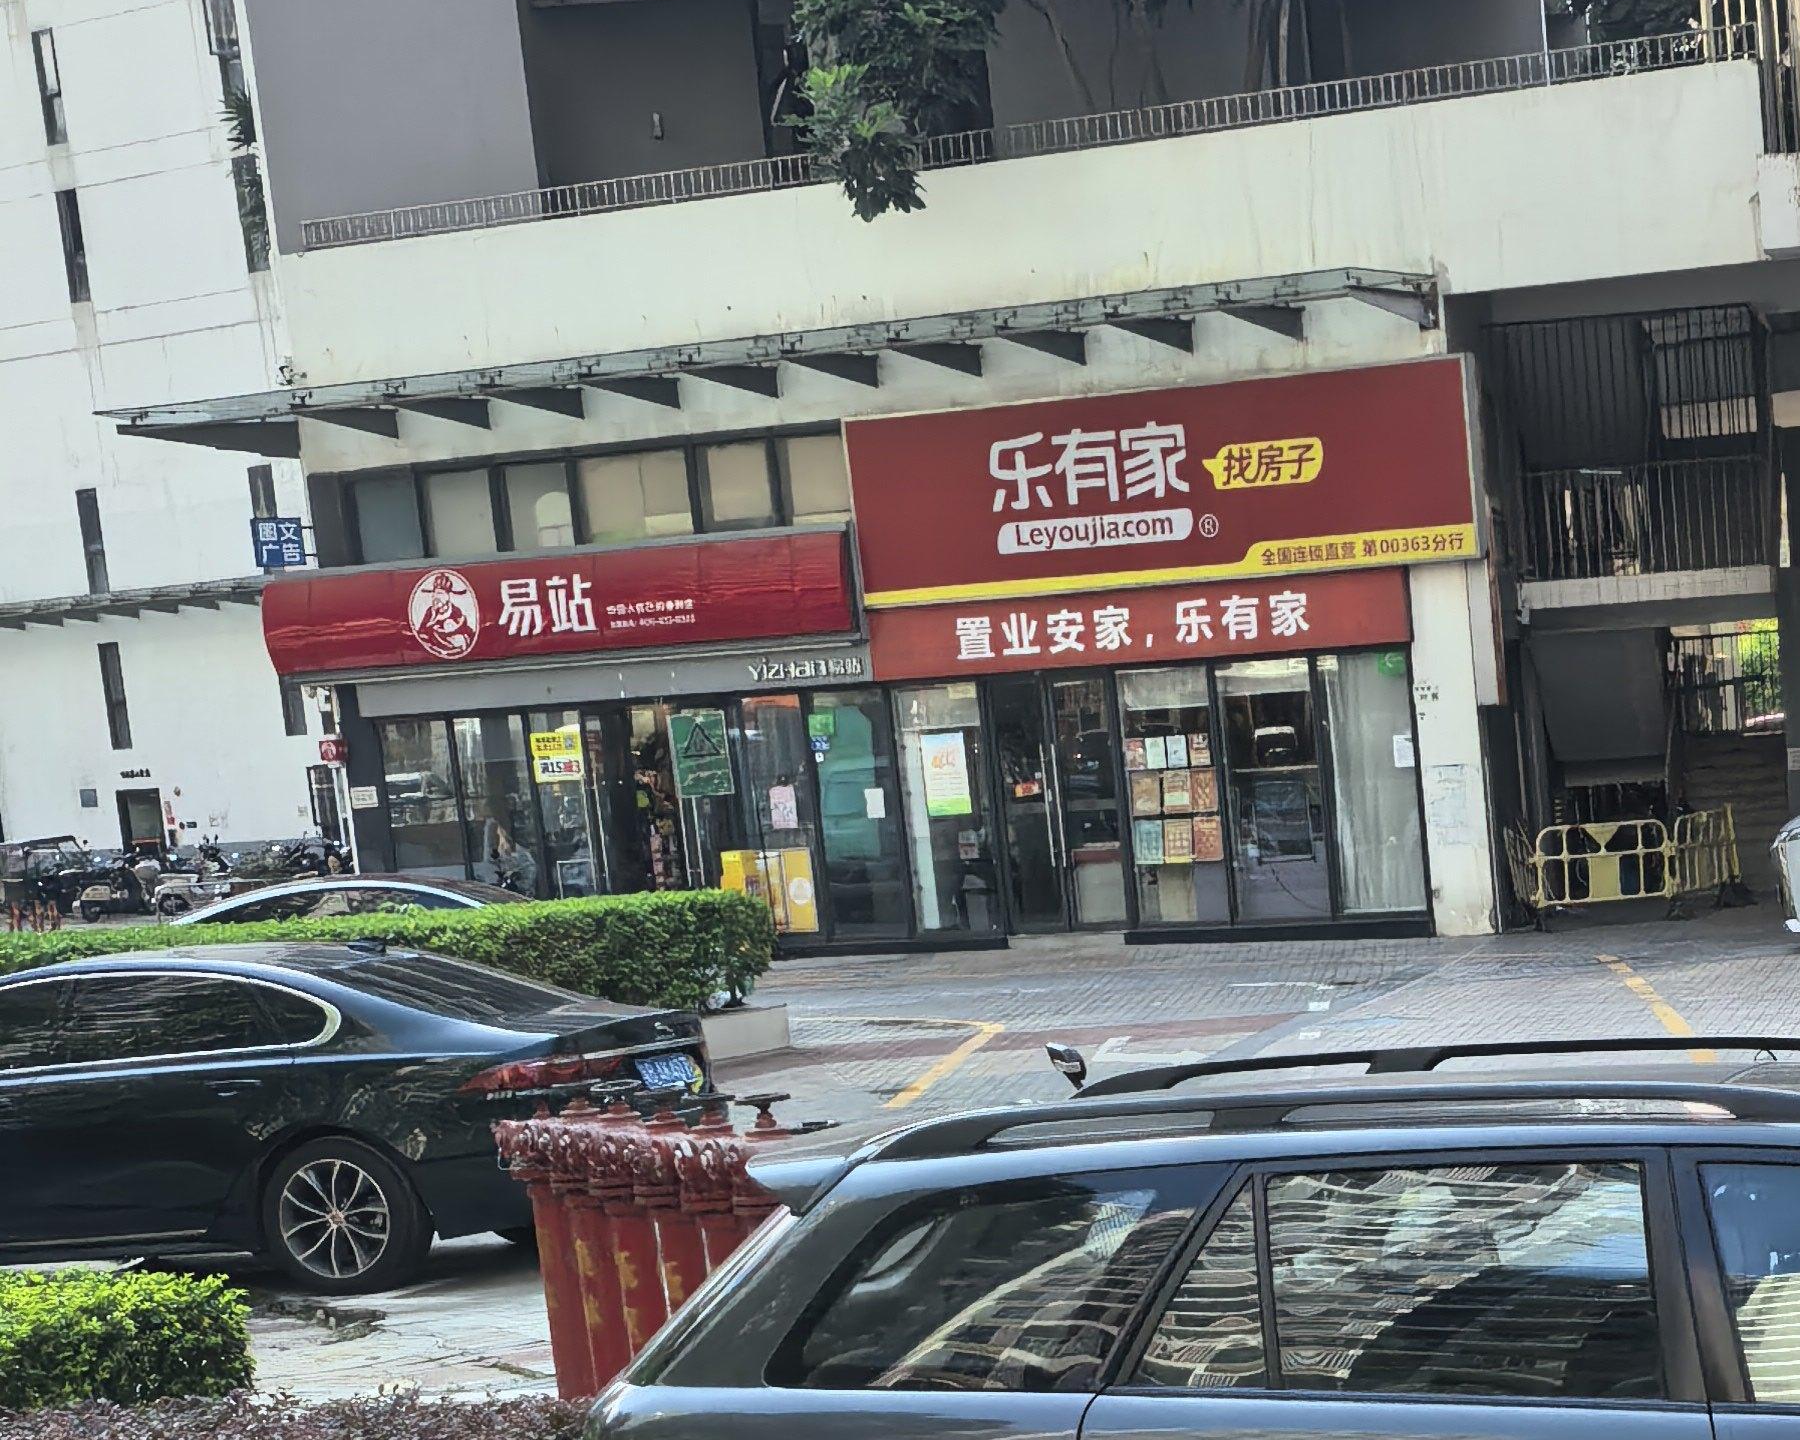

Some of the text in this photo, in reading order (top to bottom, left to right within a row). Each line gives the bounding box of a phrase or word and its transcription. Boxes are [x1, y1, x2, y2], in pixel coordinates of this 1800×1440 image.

[989, 421, 1190, 512] 乐有家
[1222, 443, 1316, 485] 找房子
[1015, 514, 1174, 551] Leyoujia.com
[499, 574, 597, 636] 易站
